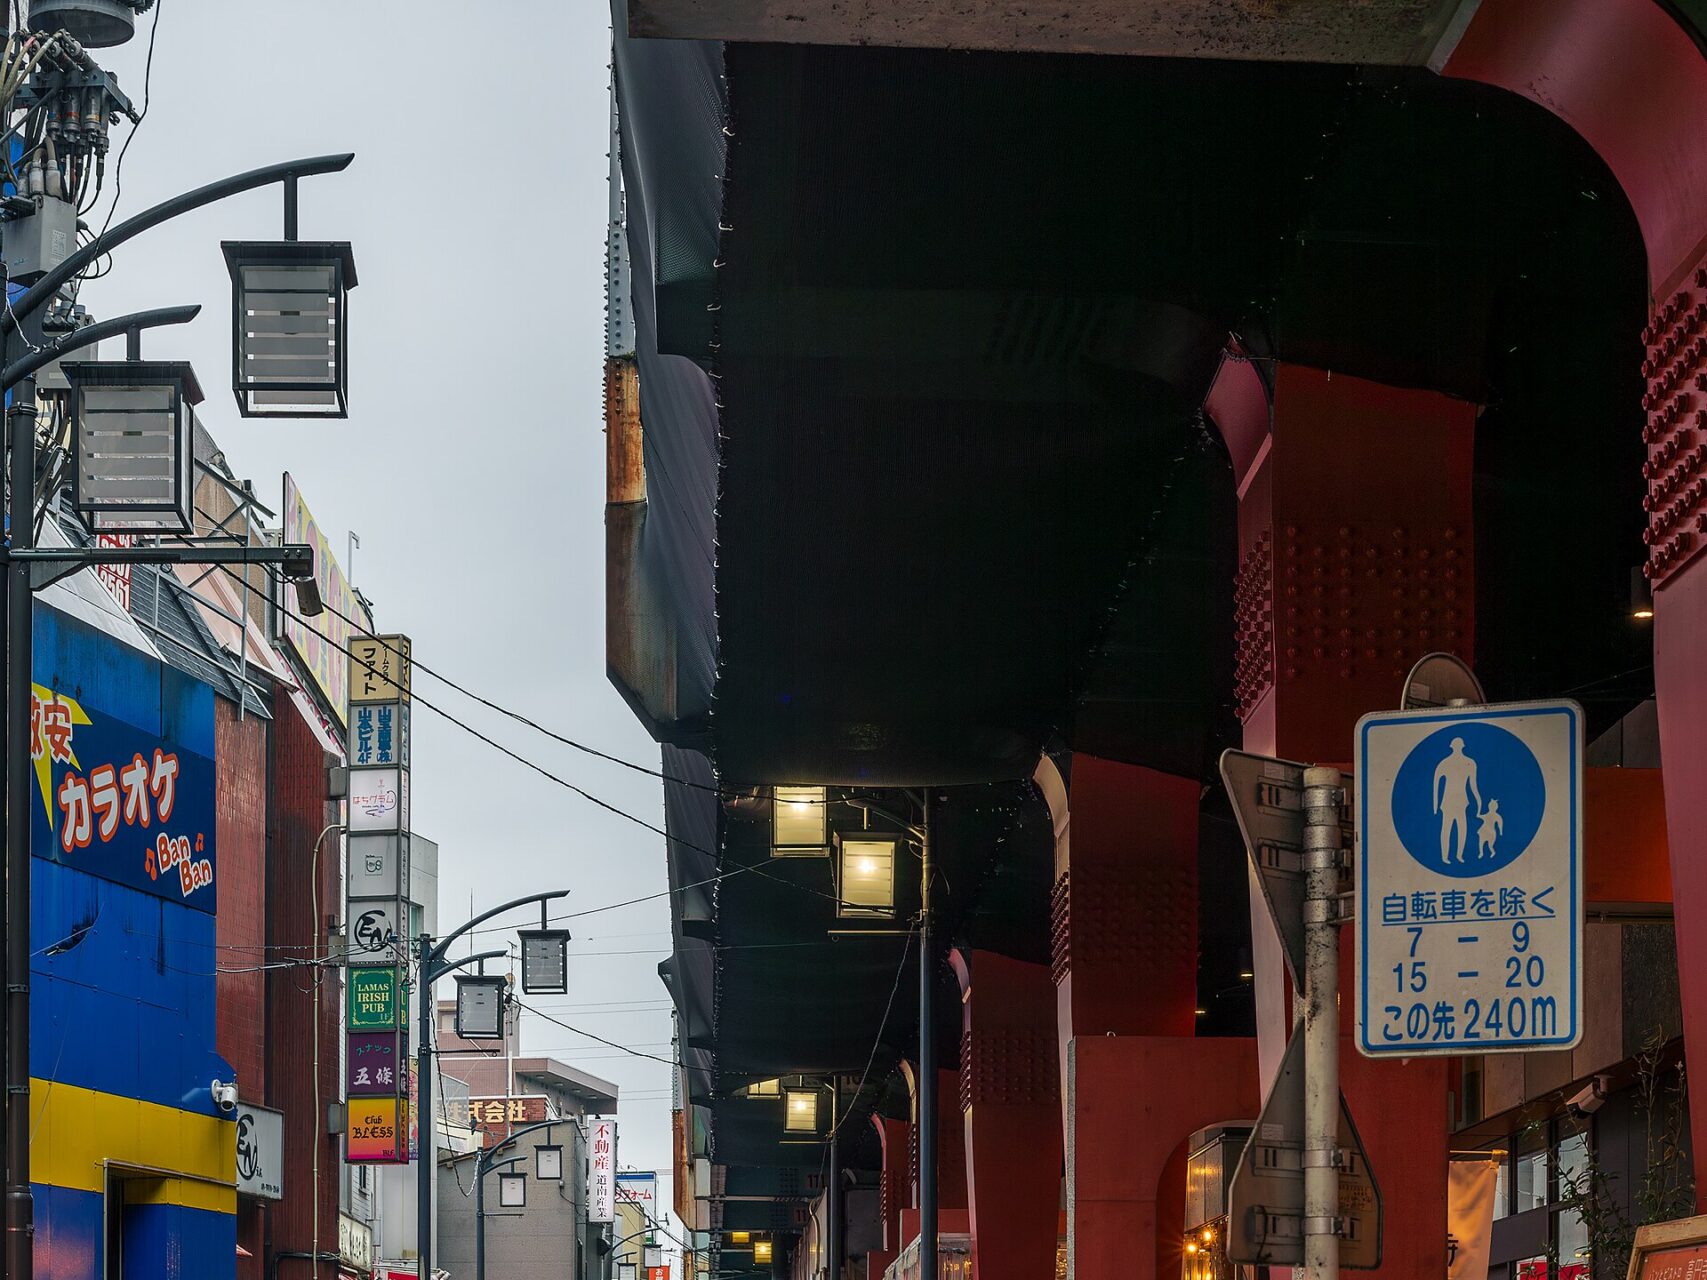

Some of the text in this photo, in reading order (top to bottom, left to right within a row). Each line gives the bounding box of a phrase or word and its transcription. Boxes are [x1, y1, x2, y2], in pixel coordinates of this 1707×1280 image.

[58, 748, 179, 853] カラオケ
[156, 832, 192, 875] Ban
[179, 858, 213, 898] Ban
[1383, 886, 1555, 922] 自転車を除く
[1407, 926, 1423, 958] 7
[1512, 920, 1530, 953] 9
[358, 983, 389, 992] LAMAS
[1392, 961, 1428, 993] 15
[1505, 955, 1545, 988] 20
[357, 992, 390, 1003] IRISH
[362, 1003, 385, 1013] PUB
[352, 1126, 394, 1139] BLESS
[364, 1115, 383, 1125] Club
[594, 1123, 610, 1171] 不動産
